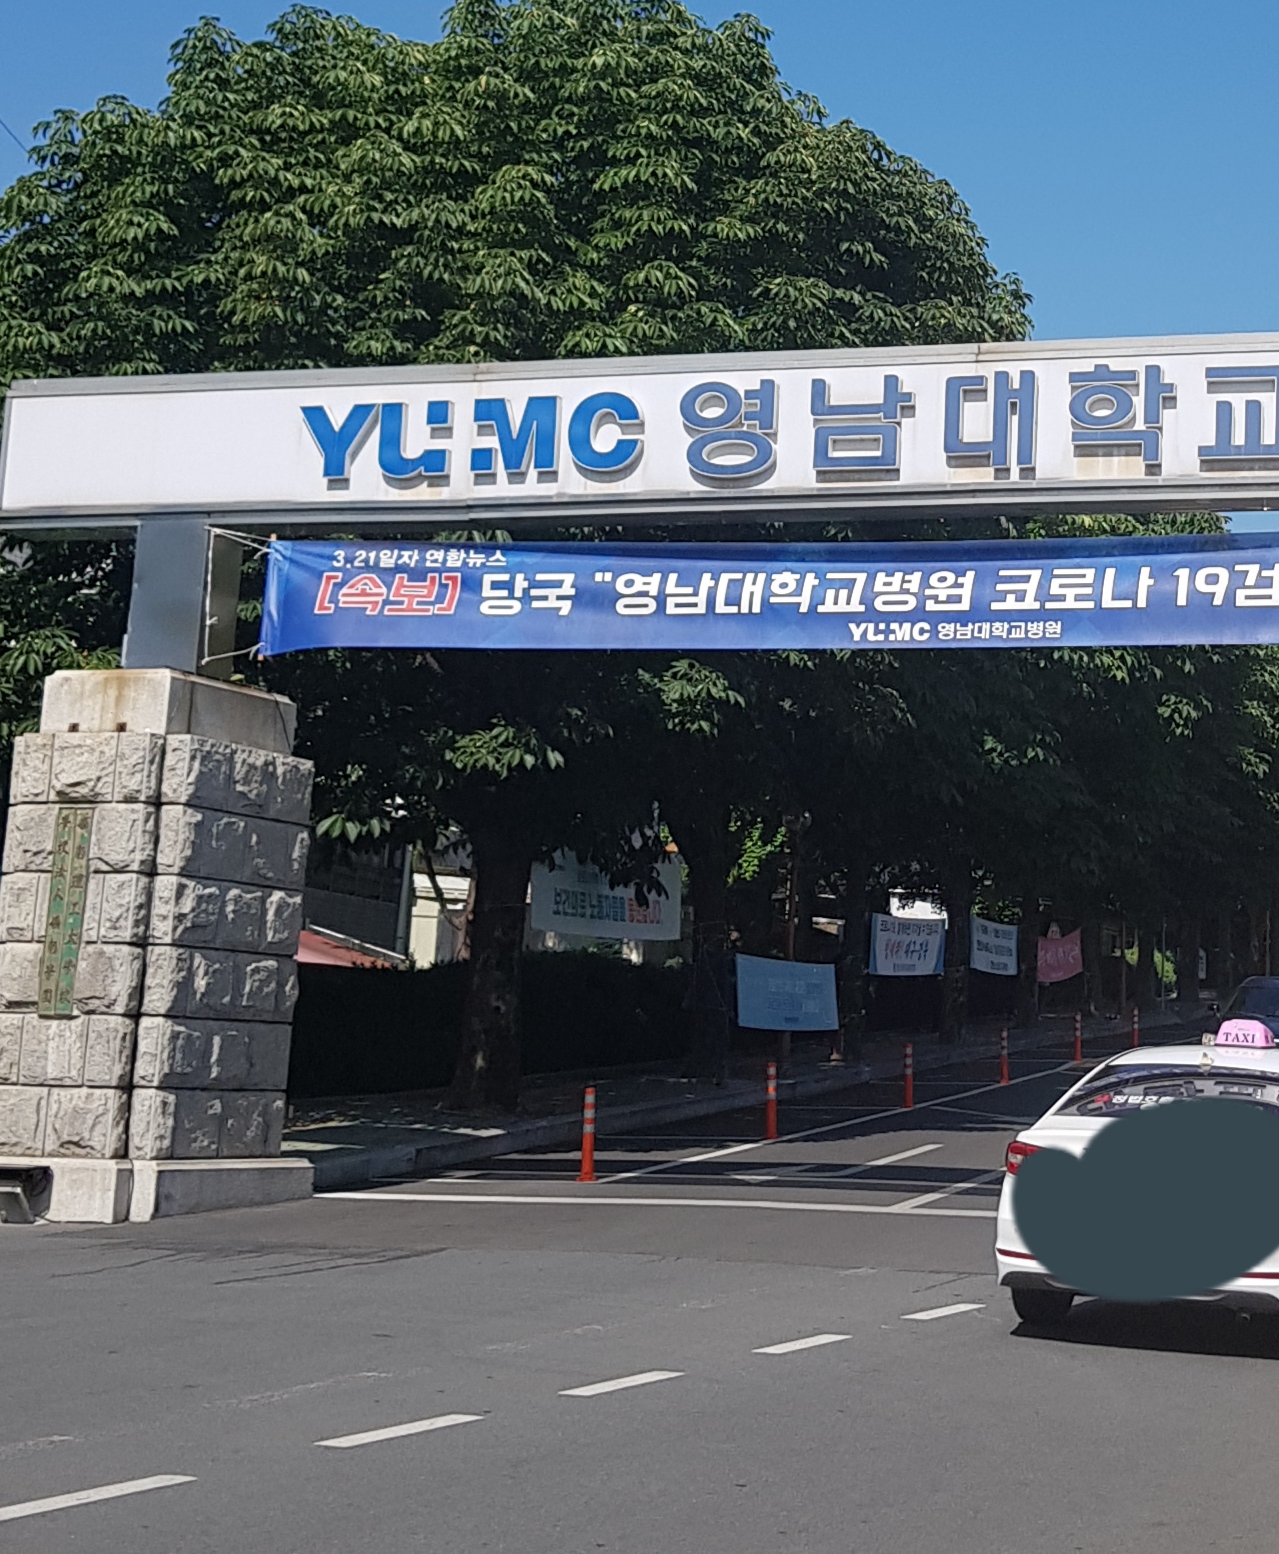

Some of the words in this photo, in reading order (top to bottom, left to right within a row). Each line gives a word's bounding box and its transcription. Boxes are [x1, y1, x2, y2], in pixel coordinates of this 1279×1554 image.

[332, 549, 419, 568] 3.21일자
[425, 549, 507, 568] 연합뉴스
[313, 572, 462, 615] [속보]
[479, 572, 576, 615] 당국
[989, 566, 1155, 611] 코로나
[937, 621, 1062, 639] 영남대학교병원
[1223, 1032, 1256, 1043] TAXI
